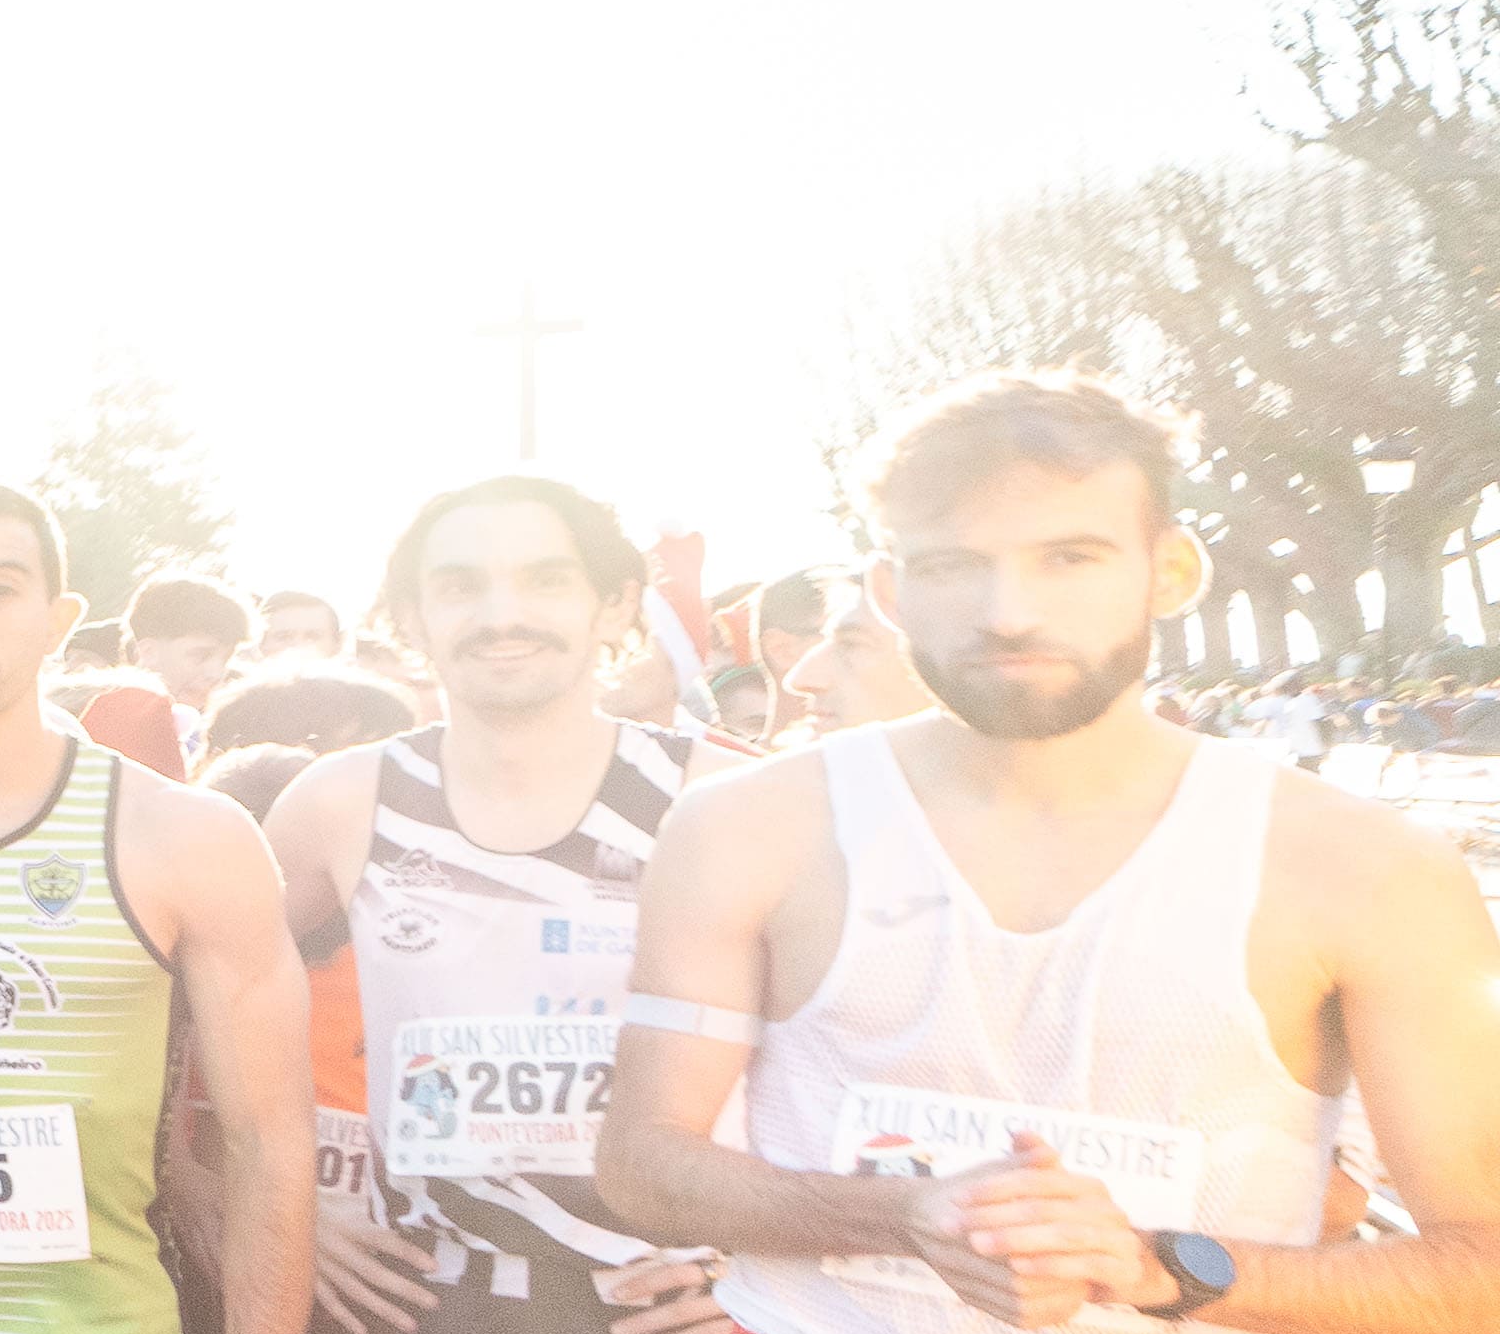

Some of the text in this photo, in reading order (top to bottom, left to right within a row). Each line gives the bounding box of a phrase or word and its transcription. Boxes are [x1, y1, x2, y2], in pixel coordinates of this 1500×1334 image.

[440, 1025, 482, 1056] SAN
[490, 1024, 616, 1056] SILVESTRE
[467, 1061, 615, 1115] 2672
[466, 1120, 579, 1145] PONTEVEDRA
[922, 1103, 990, 1149] SAN
[35, 1209, 75, 1232] 2025
